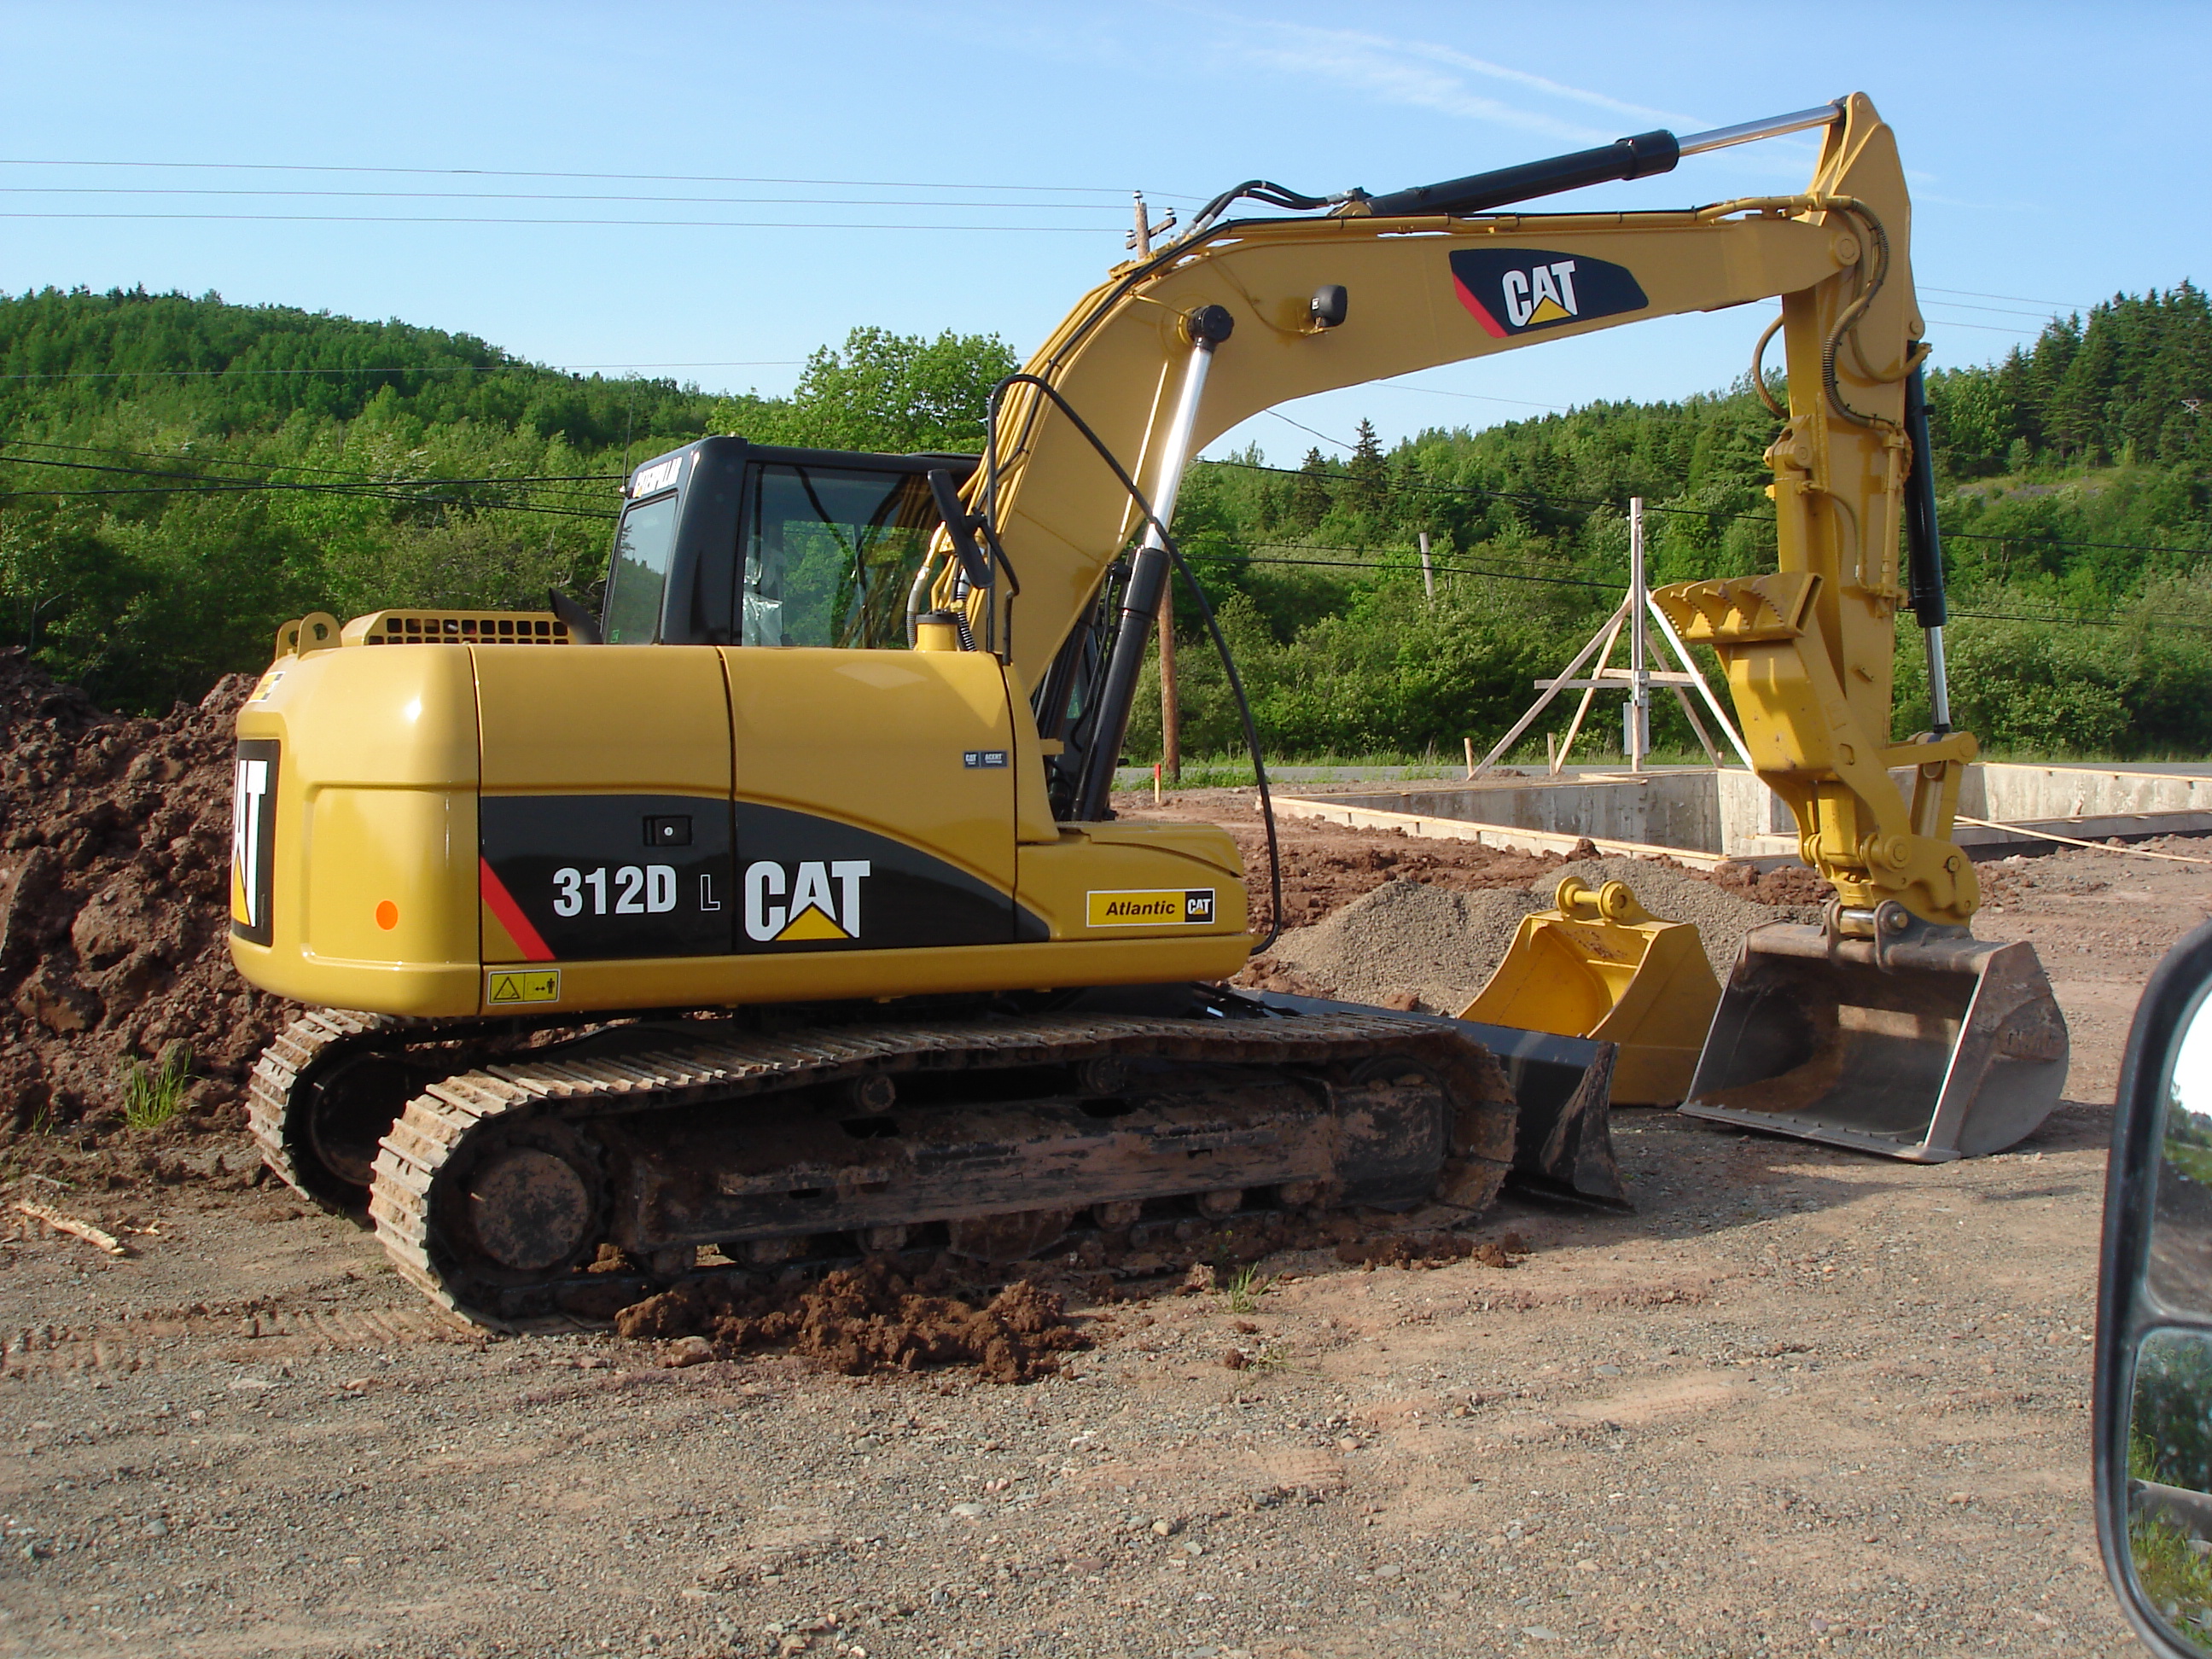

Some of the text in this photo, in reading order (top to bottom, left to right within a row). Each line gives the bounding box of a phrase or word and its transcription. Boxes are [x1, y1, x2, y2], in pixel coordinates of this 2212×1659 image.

[1502, 259, 1578, 327] CAT
[552, 864, 721, 917] 312D L
[744, 860, 871, 941] CAT
[1106, 898, 1212, 917] Atlantic CAT
